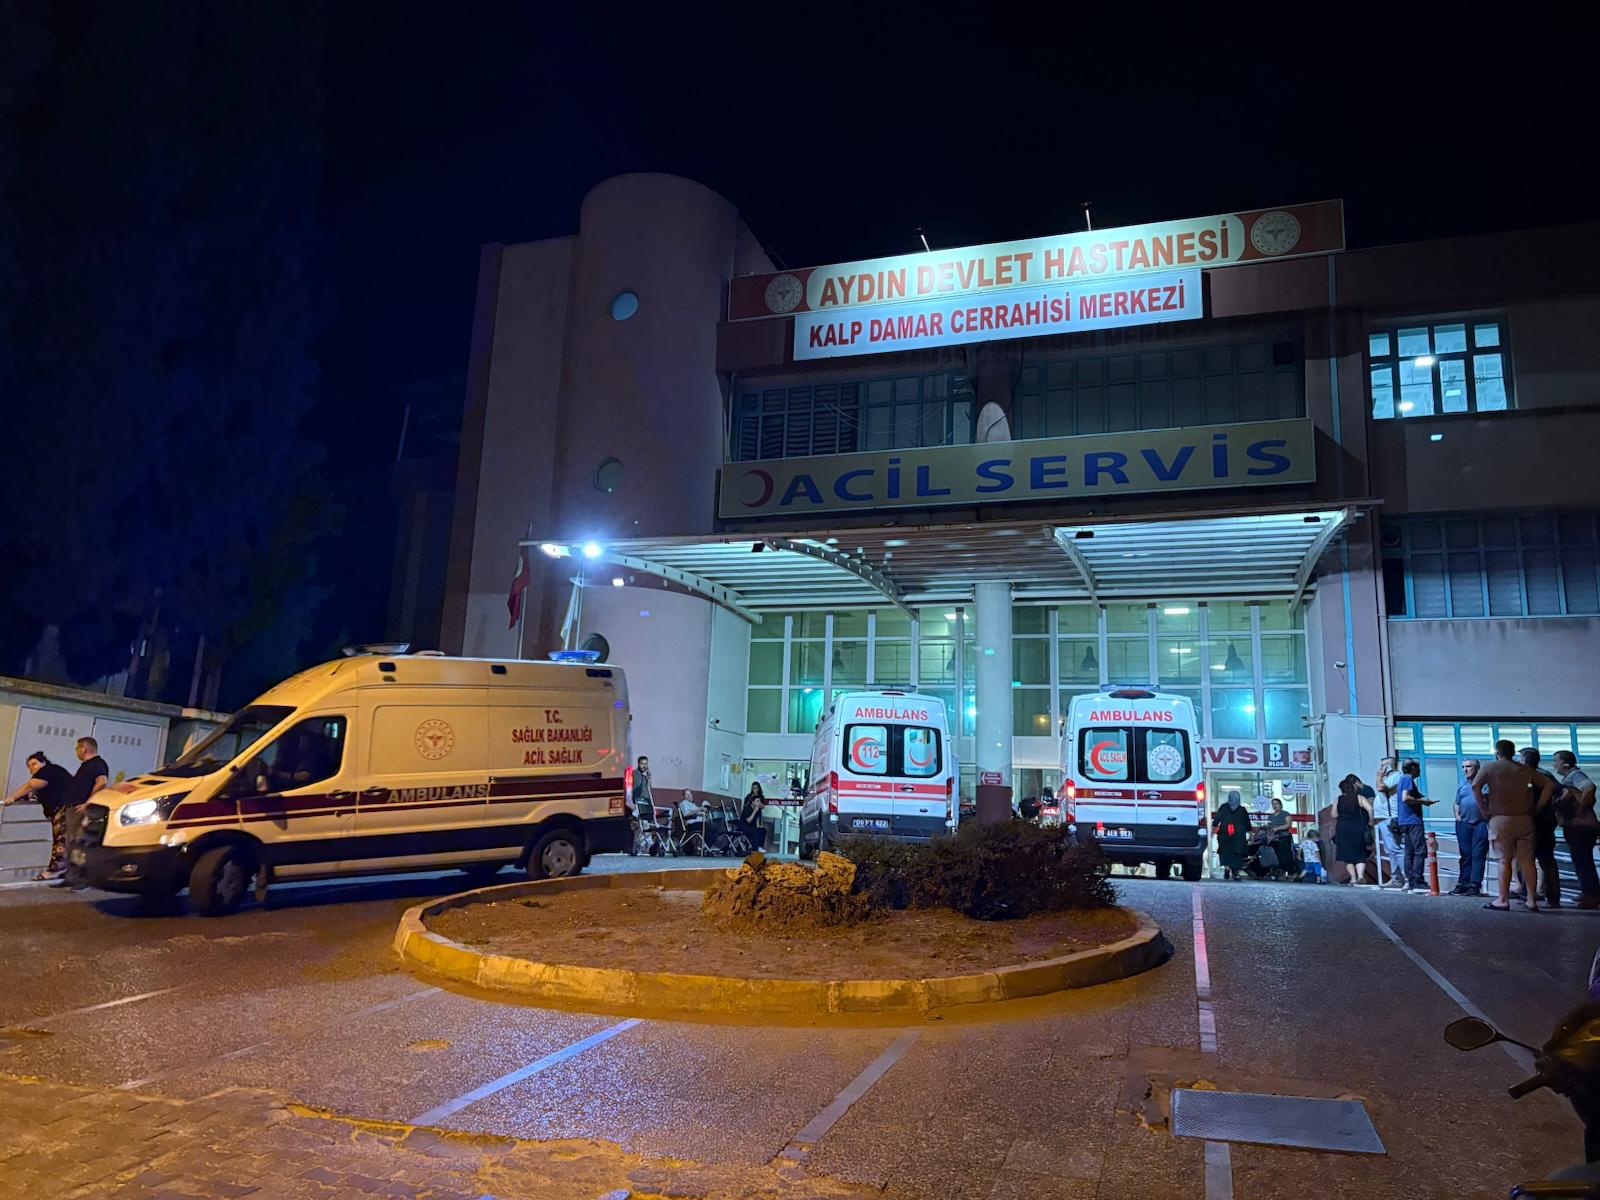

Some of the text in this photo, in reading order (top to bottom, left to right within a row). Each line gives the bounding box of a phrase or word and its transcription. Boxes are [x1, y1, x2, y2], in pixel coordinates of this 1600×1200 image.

[820, 221, 1230, 306] AYDIN DEVLET HASTANESİ
[809, 279, 1185, 348] KALP DAMAR CERRAHİSİ MERKEZİ
[779, 433, 1292, 505] ACİL SERVİS
[545, 710, 563, 724] T.C.
[855, 707, 928, 721] AMBULANS
[1090, 710, 1173, 722] AMBULANS
[512, 725, 592, 743] SAĞLIK BAKANLIĞI
[524, 747, 583, 765] ACİL SAĞLIK
[862, 745, 879, 759] 112
[1269, 744, 1282, 761] B
[386, 785, 487, 803] AMBULANS
